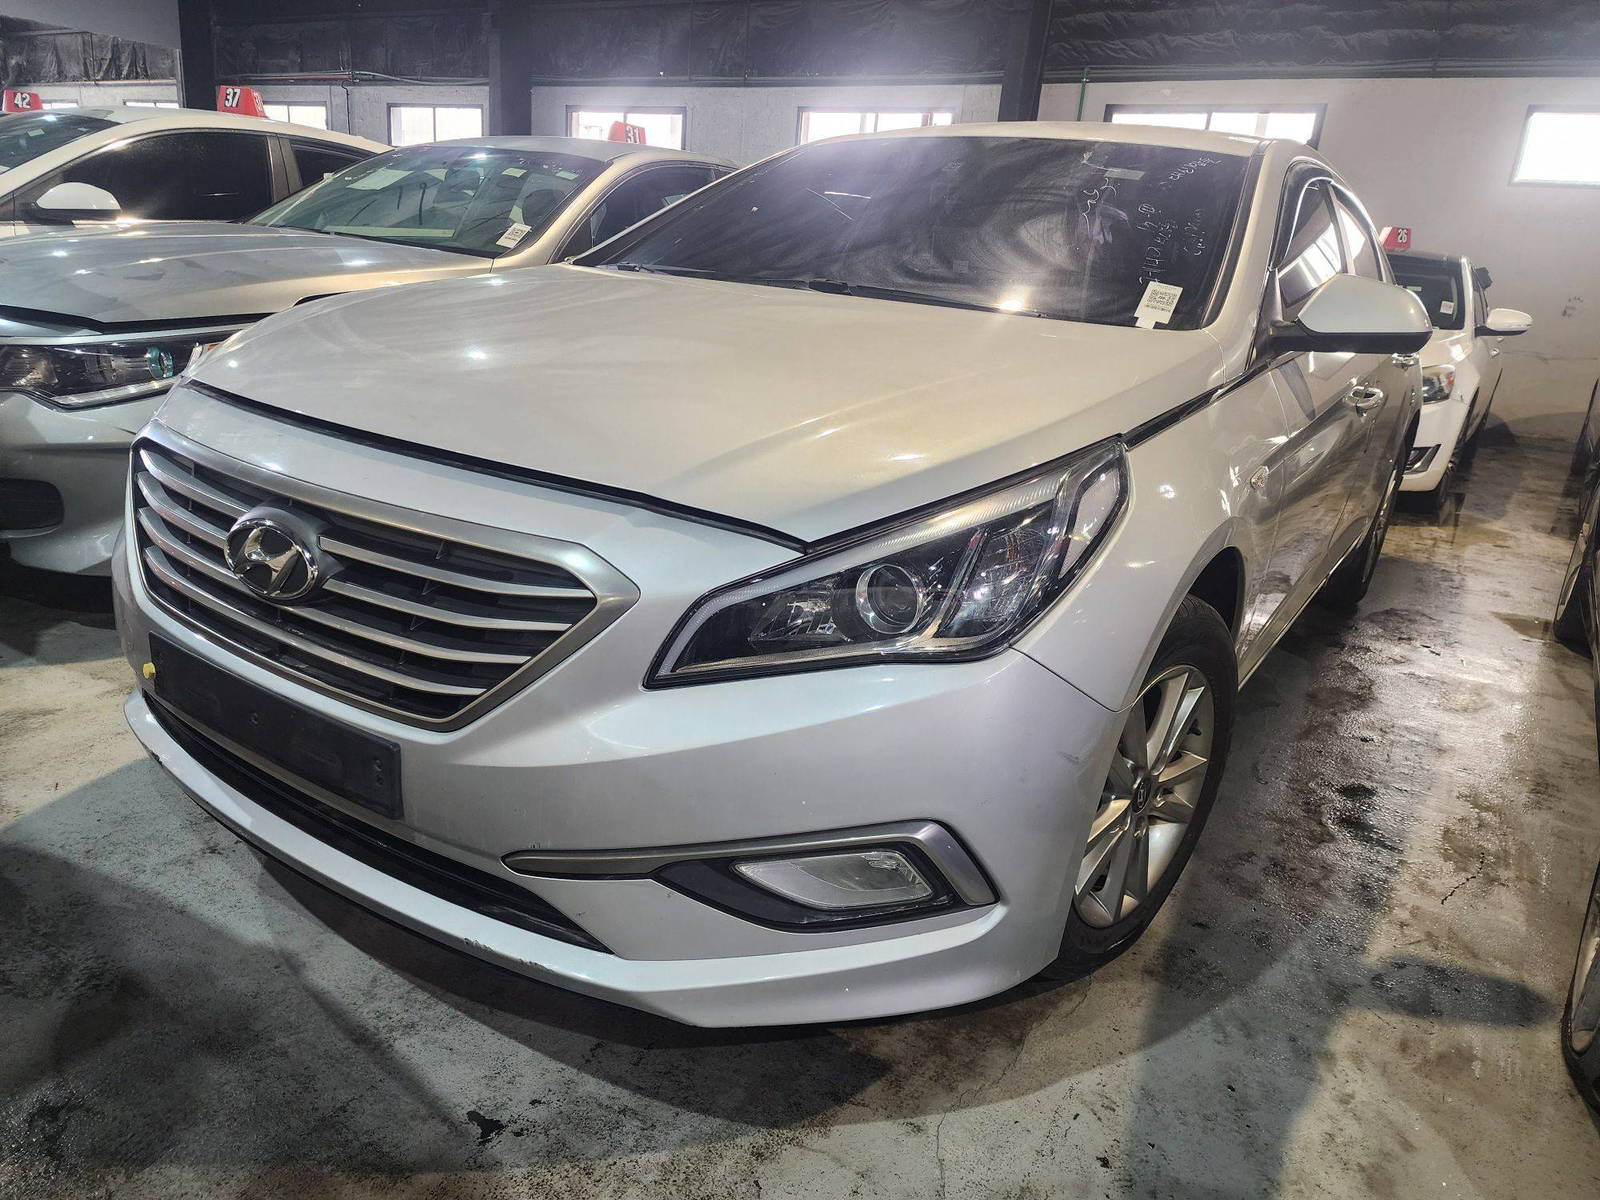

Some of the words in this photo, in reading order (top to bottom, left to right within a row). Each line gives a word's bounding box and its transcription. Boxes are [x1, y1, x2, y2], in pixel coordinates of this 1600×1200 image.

[14, 92, 31, 109] 42
[224, 87, 241, 107] 37
[625, 124, 640, 144] 31
[1397, 228, 1408, 243] 26
